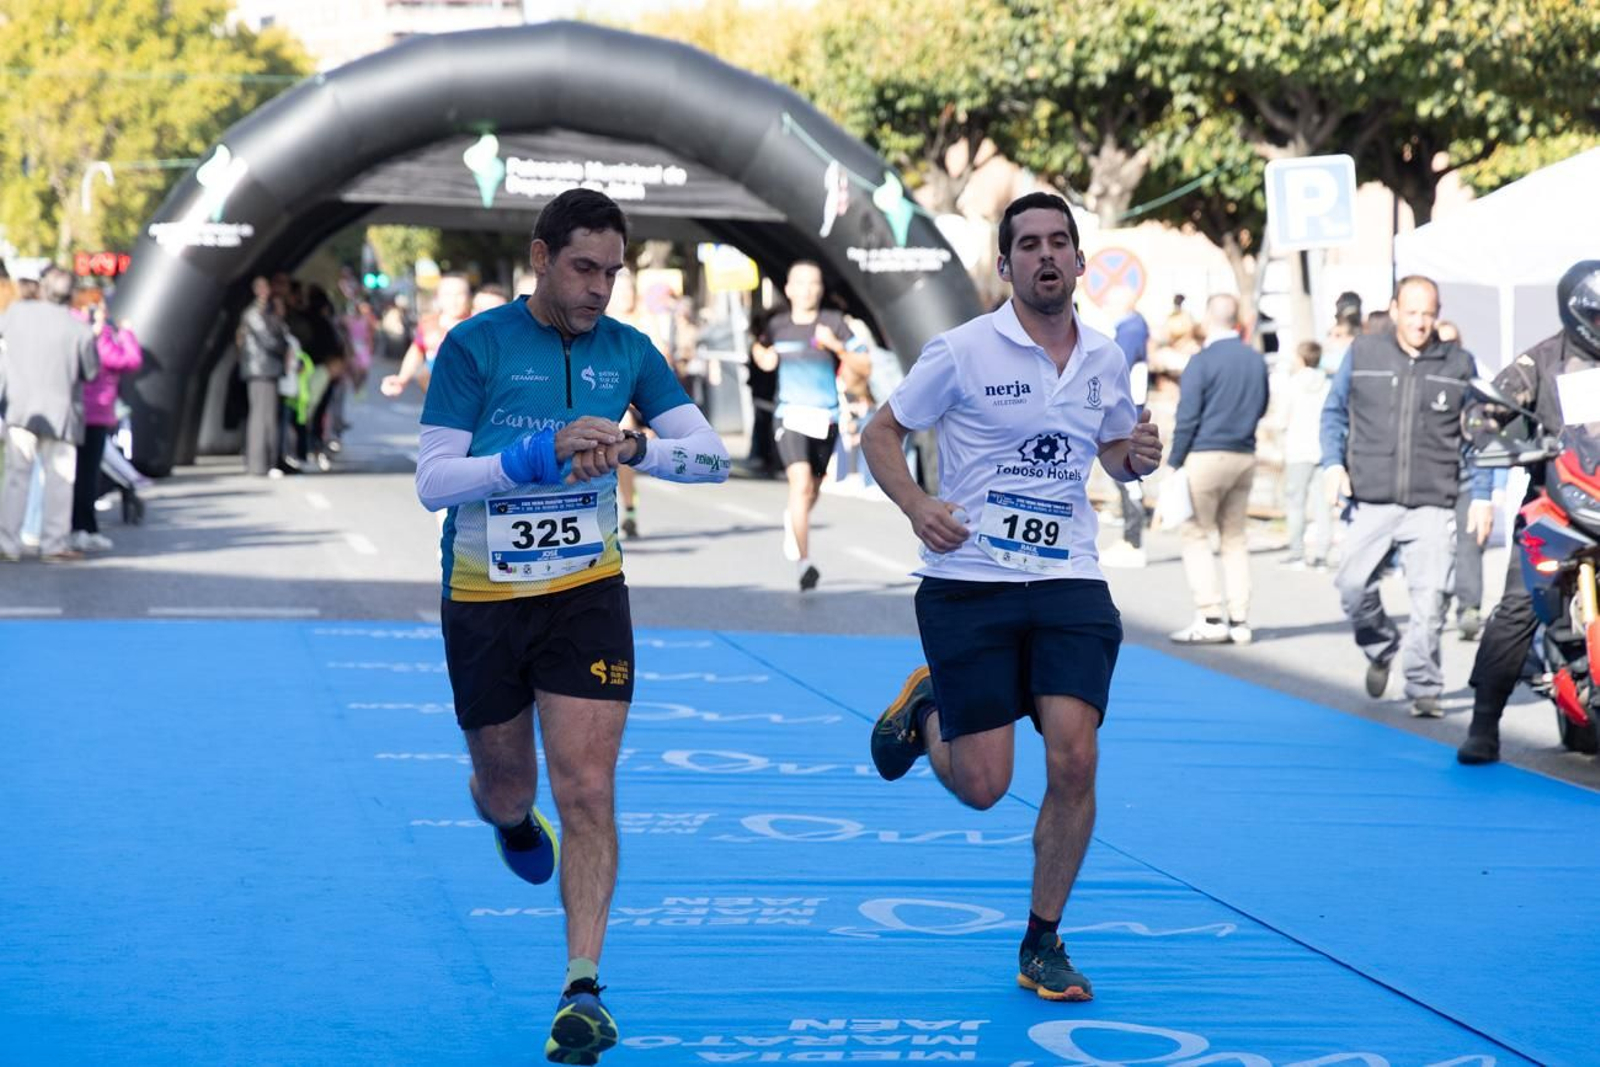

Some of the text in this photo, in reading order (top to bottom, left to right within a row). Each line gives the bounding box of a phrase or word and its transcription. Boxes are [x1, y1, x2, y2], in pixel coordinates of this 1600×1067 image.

[1285, 168, 1339, 240] P
[985, 380, 1031, 397] nerja
[996, 464, 1082, 481] Toboso Hotels
[511, 516, 581, 549] 325
[1003, 513, 1060, 546] 189
[788, 1018, 991, 1033] JAÉN
[620, 1035, 979, 1049] MARATÓ
[695, 1050, 976, 1062] MEDIA
